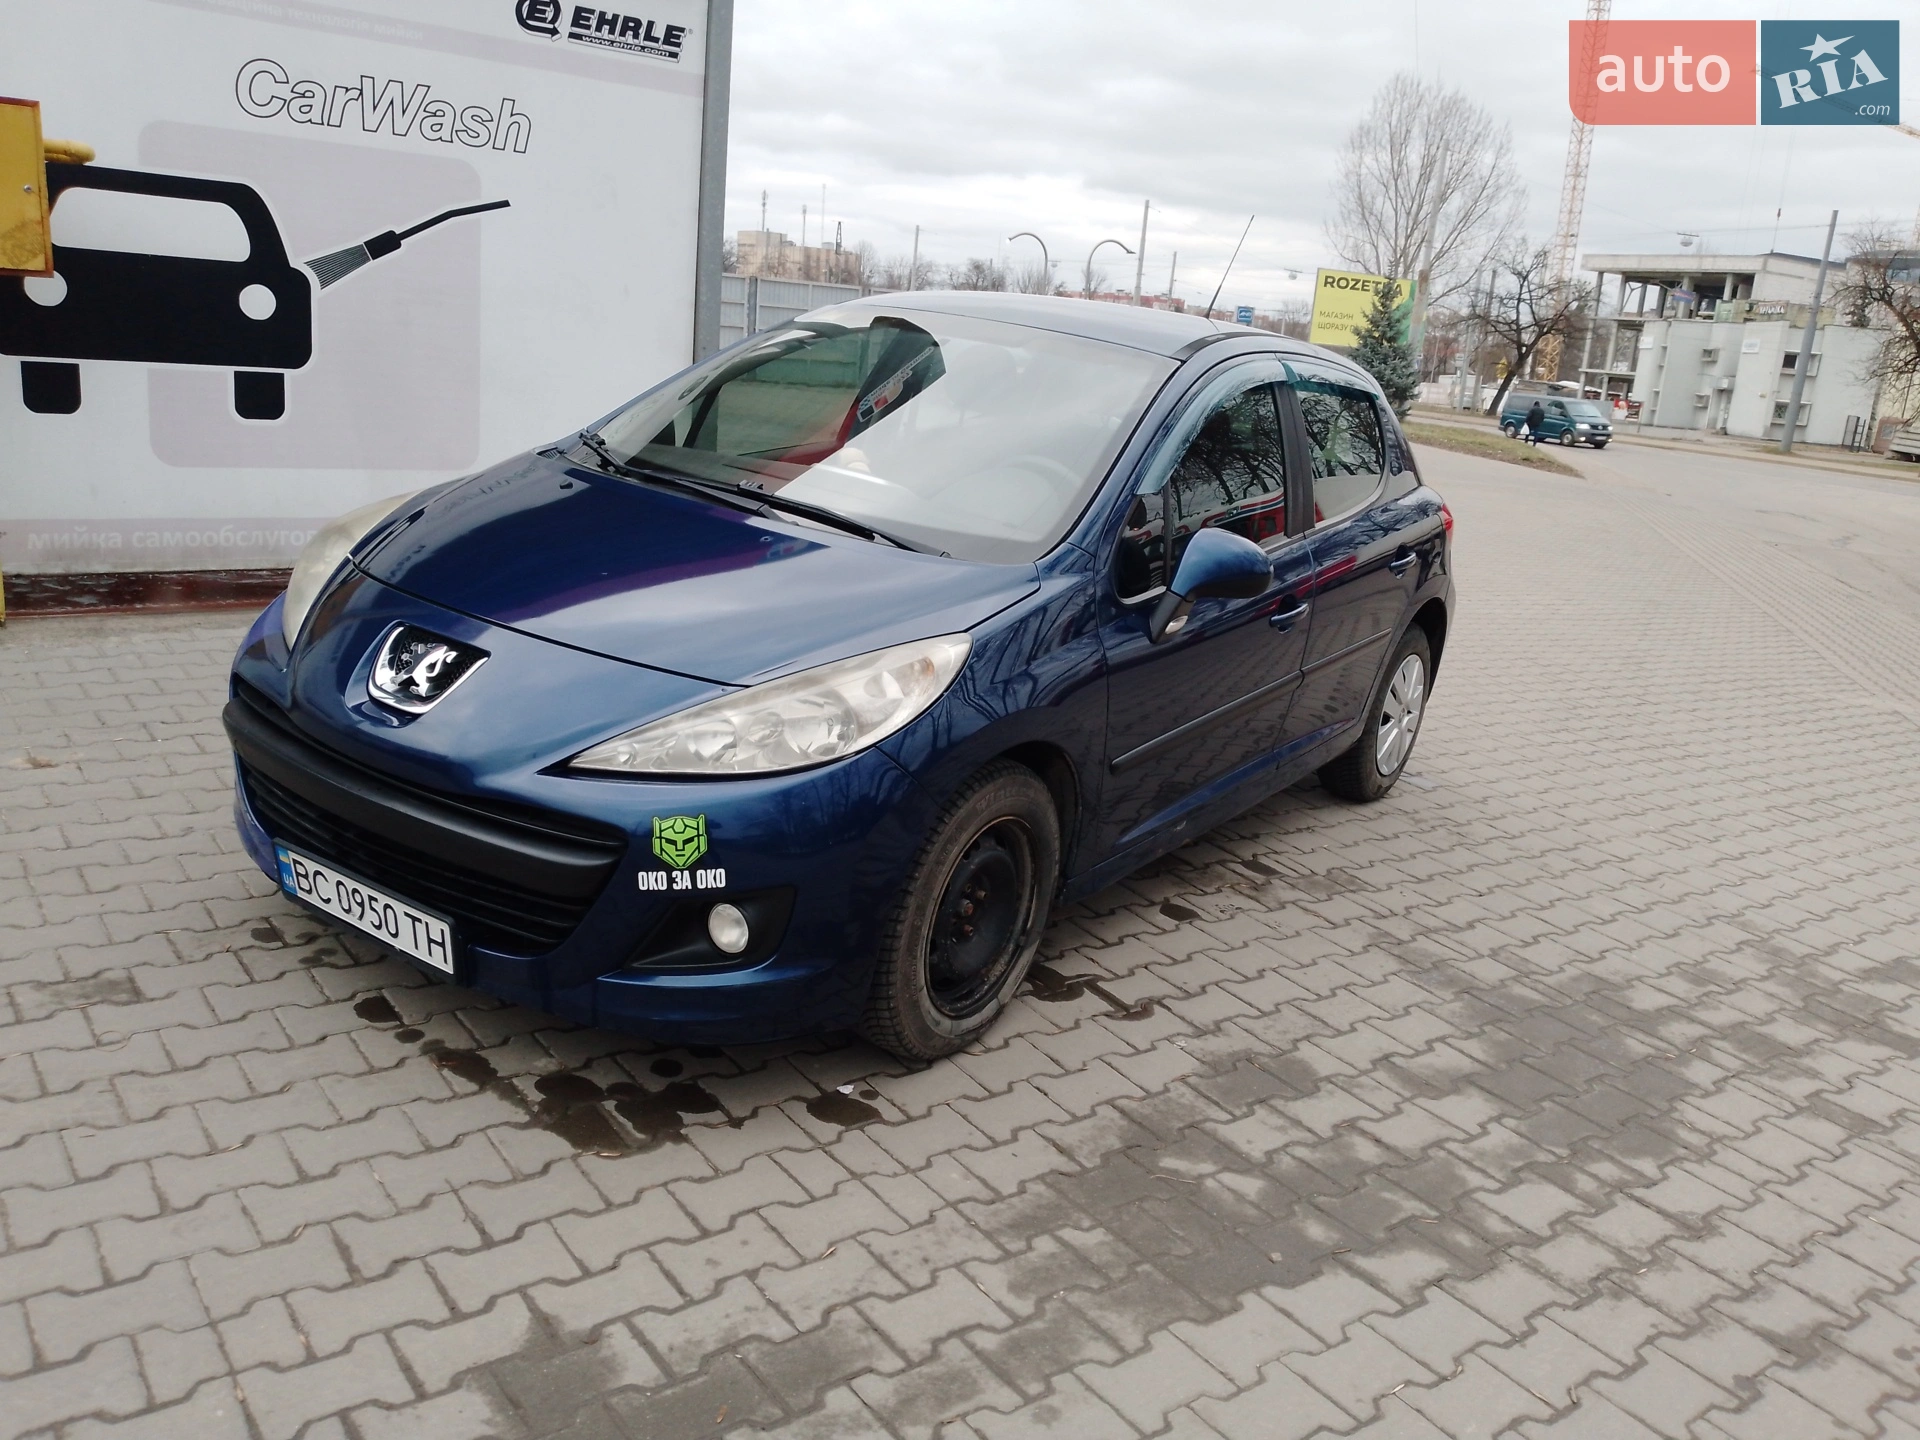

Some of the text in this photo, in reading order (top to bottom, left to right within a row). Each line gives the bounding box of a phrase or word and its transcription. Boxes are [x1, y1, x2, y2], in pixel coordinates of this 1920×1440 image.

[374, 23, 423, 41] мийки
[570, 5, 687, 52] EHRLE
[581, 35, 671, 57] www.ehrle.com
[235, 58, 532, 154] CarWash
[1323, 275, 1403, 297] ROZETA
[1317, 321, 1348, 331] ЩОРАЗУ
[1319, 310, 1354, 321] МАГАЗИН
[27, 525, 122, 550] мийка
[283, 872, 296, 888] UA
[637, 868, 726, 891] ОКО ЗА ОКО
[292, 857, 449, 965] BC 0950 TH
